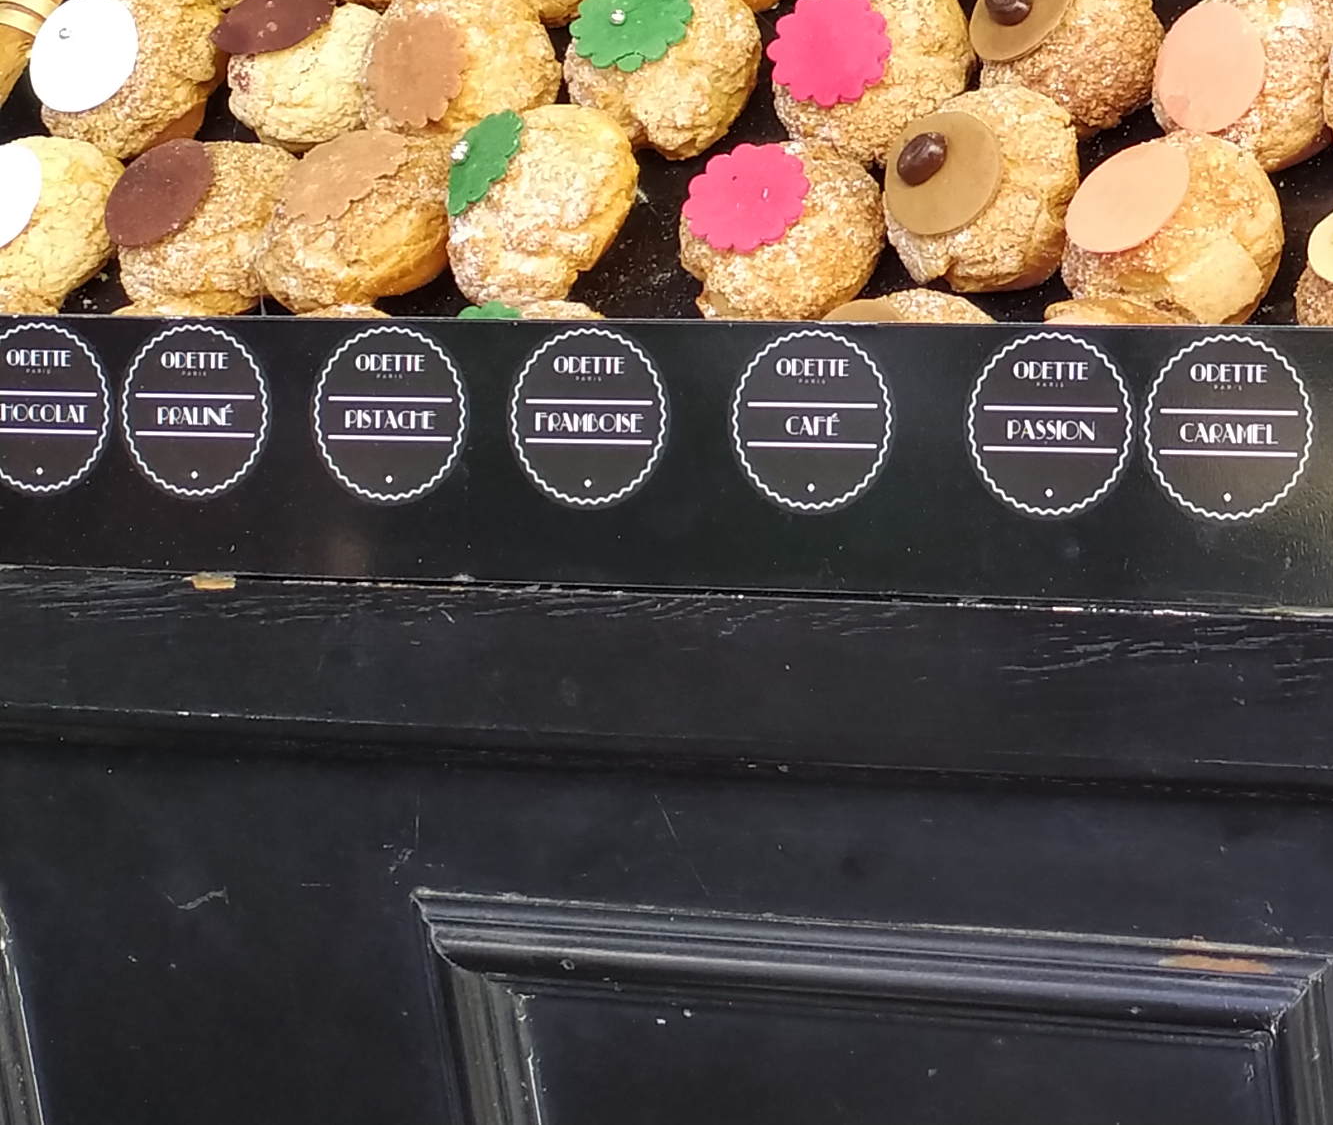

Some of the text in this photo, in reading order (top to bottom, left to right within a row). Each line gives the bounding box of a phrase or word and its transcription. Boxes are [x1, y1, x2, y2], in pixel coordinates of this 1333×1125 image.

[6, 350, 71, 367] ODETTE
[161, 352, 228, 369] ODETTE
[355, 354, 425, 373] ODETTE
[553, 356, 625, 374] ODETTE
[776, 359, 849, 377] ODETTE
[1013, 361, 1089, 381] ODETTE
[1191, 363, 1267, 383] ODETTE
[0, 404, 88, 423] HOCOLAT
[157, 404, 233, 426] PRALINÉ
[344, 409, 436, 431] PISTACHE
[535, 412, 644, 433] FRAMBOISE
[785, 413, 840, 435] CAFÉ
[1007, 420, 1095, 441] PASSION
[1180, 423, 1278, 444] CARAMEL
